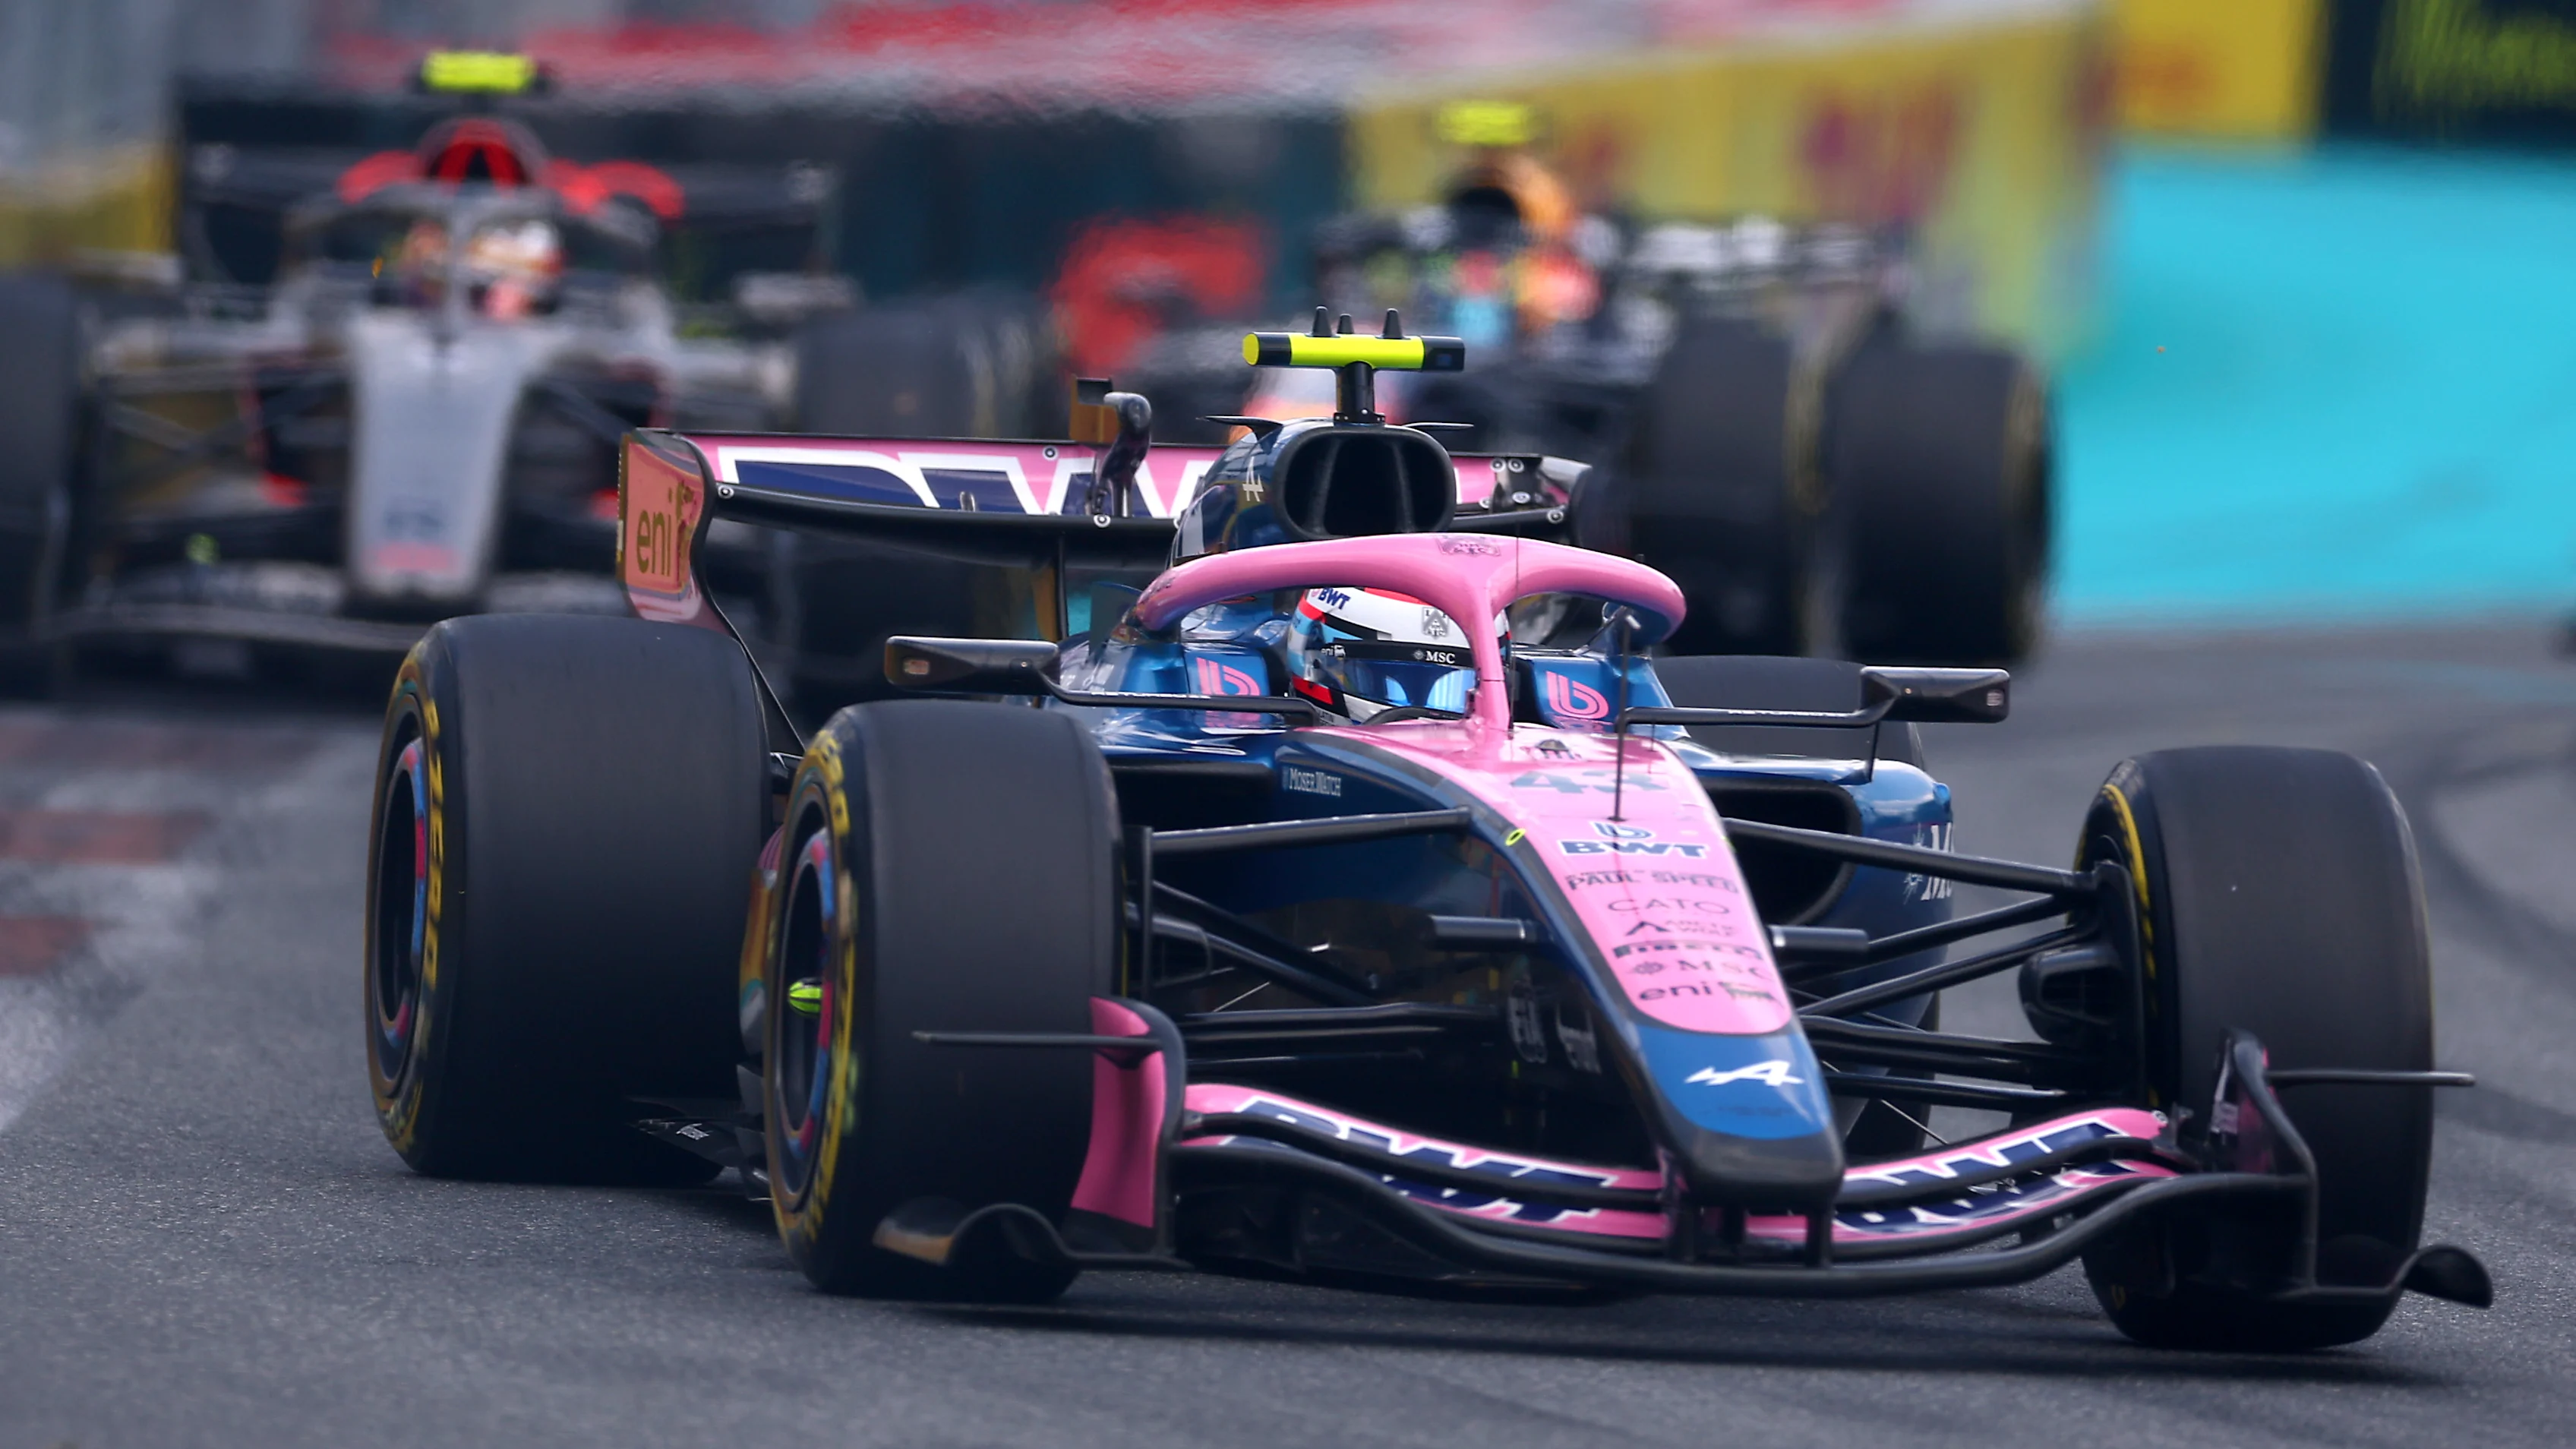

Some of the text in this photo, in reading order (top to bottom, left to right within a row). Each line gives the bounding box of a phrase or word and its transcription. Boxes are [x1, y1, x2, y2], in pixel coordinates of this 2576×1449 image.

[636, 488, 671, 577] eni
[1318, 587, 1350, 610] BWT
[1425, 650, 1456, 665] MSC
[1558, 840, 1709, 859] BWT
[1607, 898, 1730, 914] CATO
[1640, 981, 1713, 1000] eni
